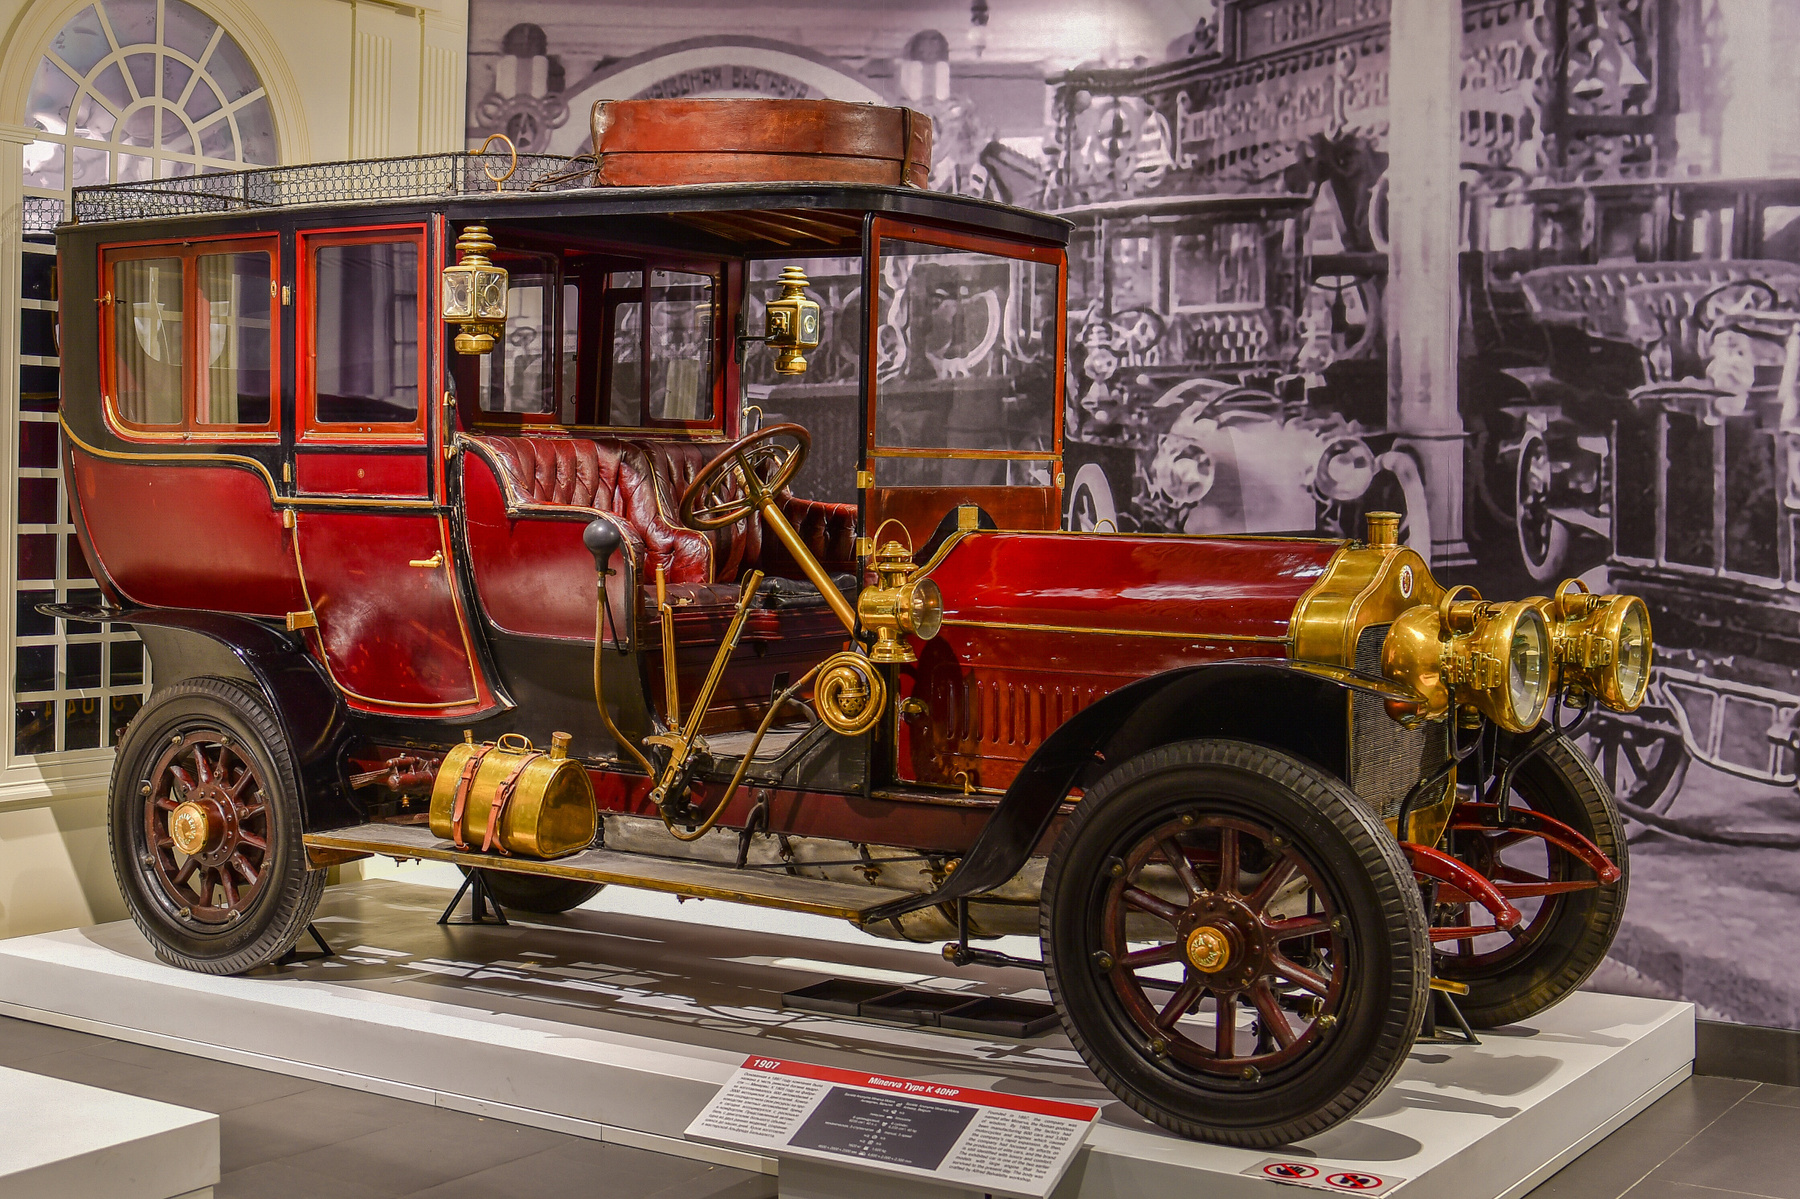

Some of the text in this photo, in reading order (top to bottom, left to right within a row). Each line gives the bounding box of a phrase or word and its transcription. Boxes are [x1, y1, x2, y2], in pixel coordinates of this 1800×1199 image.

[753, 1059, 780, 1070] 1907
[868, 1077, 960, 1097] Minerva Type K 40HP
